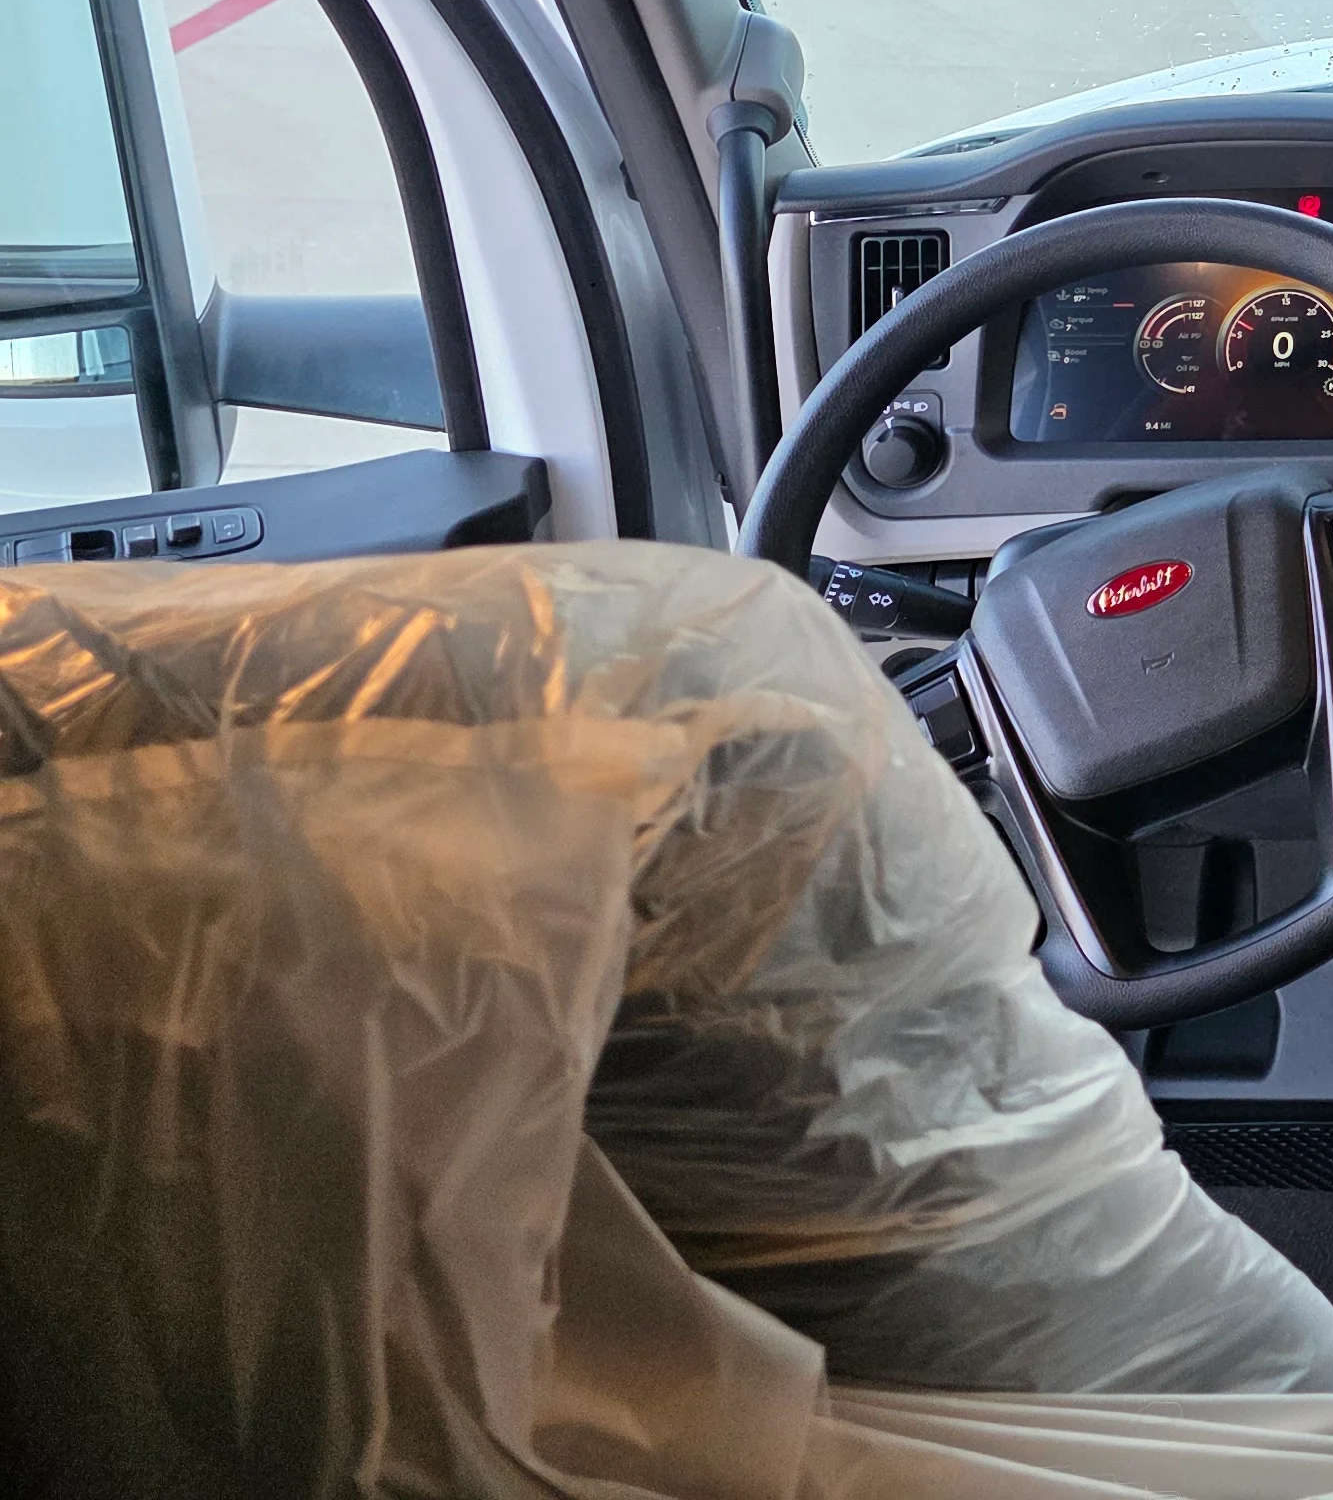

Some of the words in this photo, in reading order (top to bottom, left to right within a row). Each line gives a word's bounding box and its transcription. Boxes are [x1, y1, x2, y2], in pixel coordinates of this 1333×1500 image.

[1074, 287, 1085, 295] Oil
[1087, 287, 1108, 296] Temp
[1192, 300, 1205, 308] 127
[1282, 298, 1291, 306] 15
[1191, 312, 1204, 320] 127
[1254, 308, 1263, 316] 10
[1306, 308, 1317, 316] 20
[1067, 316, 1094, 325] Torque
[1237, 331, 1242, 339] 5
[1321, 330, 1331, 338] 25
[1272, 331, 1294, 360] 0
[1237, 361, 1243, 369] 0
[1318, 359, 1328, 368] 30
[1145, 422, 1158, 430] 9.4
[1098, 564, 1179, 613] Peterbilt
